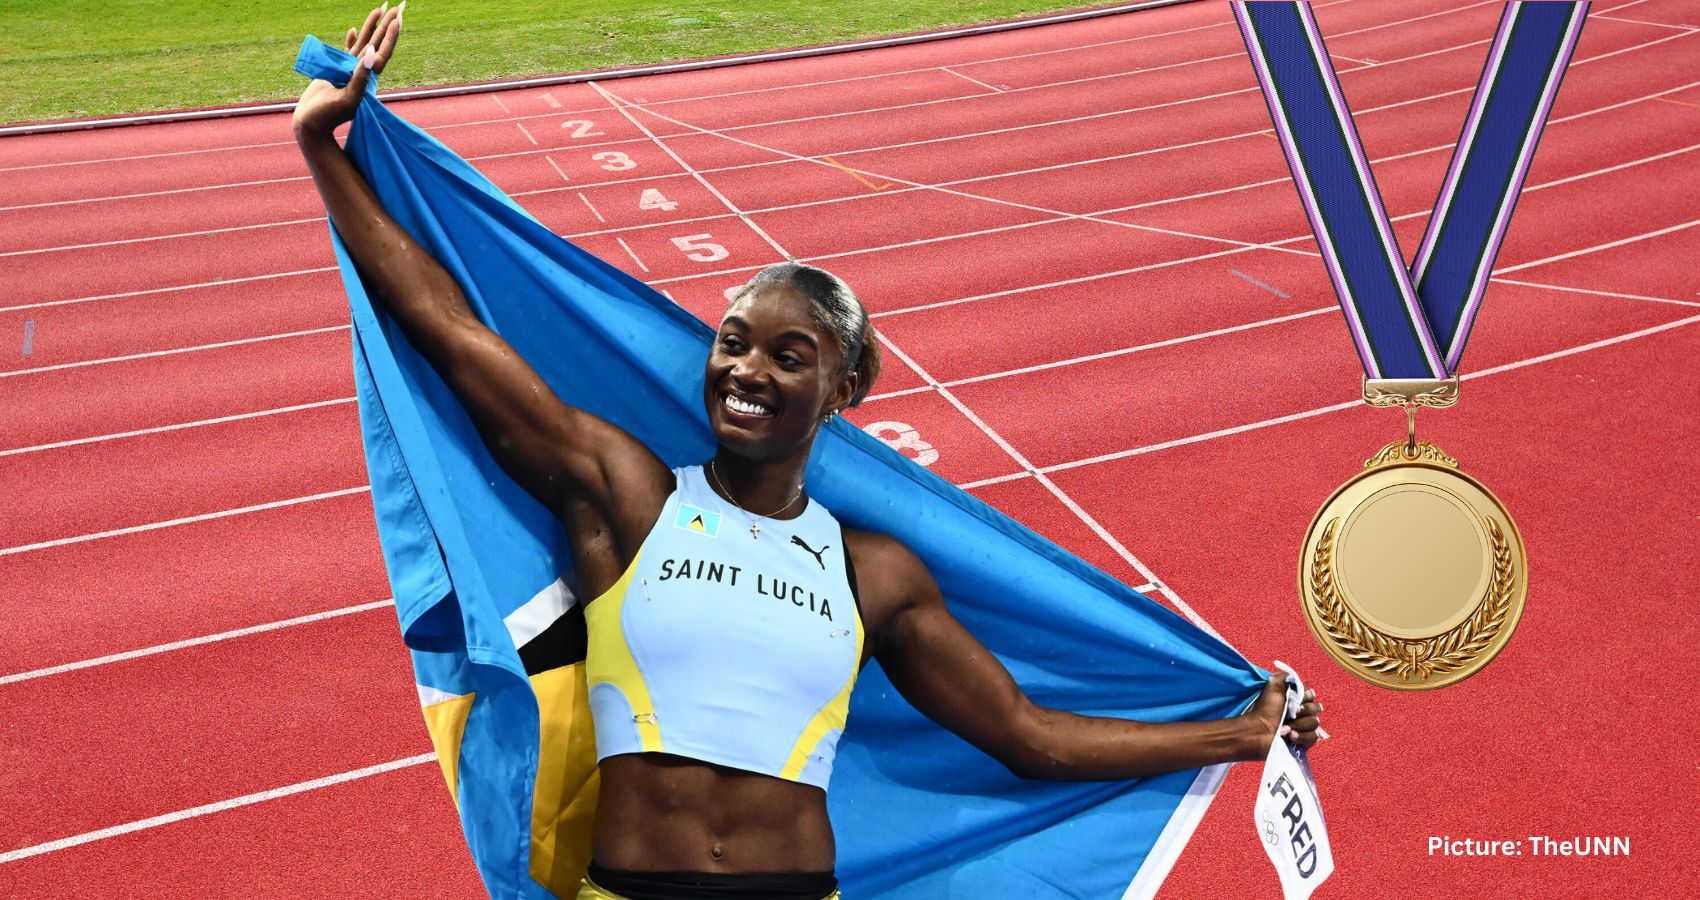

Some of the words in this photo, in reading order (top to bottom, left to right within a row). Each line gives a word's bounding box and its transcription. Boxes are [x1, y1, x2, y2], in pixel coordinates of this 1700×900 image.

[534, 92, 562, 108] 1
[561, 119, 606, 139] 2
[591, 151, 638, 171] 3
[639, 188, 680, 211] 4
[669, 232, 730, 262] 5
[862, 420, 940, 468] 8
[659, 558, 742, 587] SAINT
[757, 574, 833, 622] LUCIA
[1267, 771, 1317, 879] FRED
